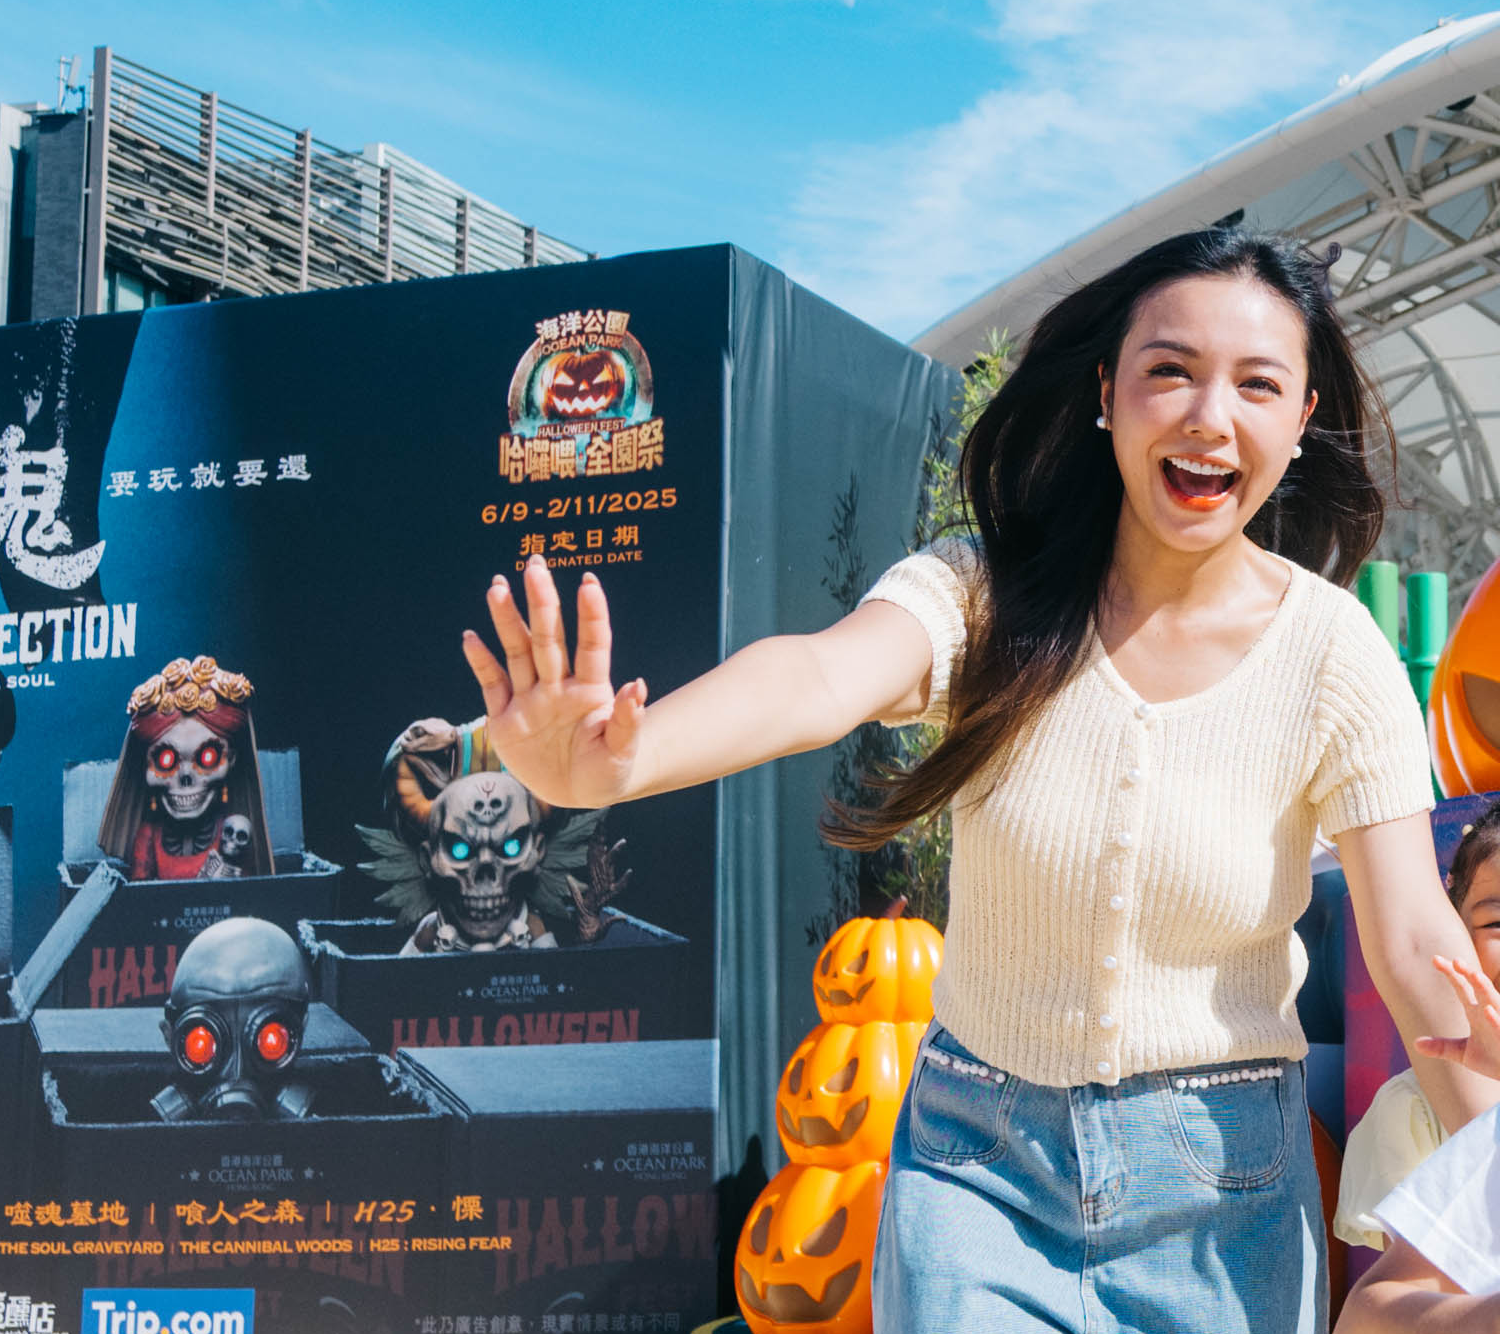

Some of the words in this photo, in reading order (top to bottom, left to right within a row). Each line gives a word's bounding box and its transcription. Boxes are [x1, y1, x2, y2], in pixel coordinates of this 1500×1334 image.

[535, 309, 631, 344] 海洋公園
[541, 337, 587, 356] OCEAN
[588, 334, 623, 349] PARK
[537, 421, 597, 437] HALLOWEEN
[599, 418, 626, 431] FEST
[481, 502, 528, 524] 6/9
[548, 488, 678, 518] 2/11/2025
[519, 525, 640, 556] 指定日期
[515, 554, 603, 572] DGNATED
[607, 550, 643, 564] DATE
[6, 673, 55, 689] SOUL
[174, 918, 210, 928] OCEAN
[481, 986, 520, 998] OCEAN
[523, 985, 549, 996] PARK
[613, 1158, 667, 1172] OCEAN
[670, 1156, 706, 1170] PARK
[208, 1169, 257, 1183] OCEAN
[260, 1168, 294, 1182] PARK
[4, 1200, 129, 1227] 噬魂墓地
[175, 1198, 304, 1226] 喰人之森
[354, 1200, 416, 1223] H25
[452, 1195, 485, 1222] 慄
[0, 1242, 29, 1254] THE
[31, 1242, 70, 1254] SOUL
[73, 1241, 164, 1254] GRAVEYARD
[180, 1241, 210, 1254] THE
[212, 1240, 293, 1254] CANNIBAL
[295, 1239, 353, 1253] WOODS
[370, 1239, 400, 1252] H25
[412, 1238, 467, 1251] RISING
[469, 1237, 512, 1250] FEAR
